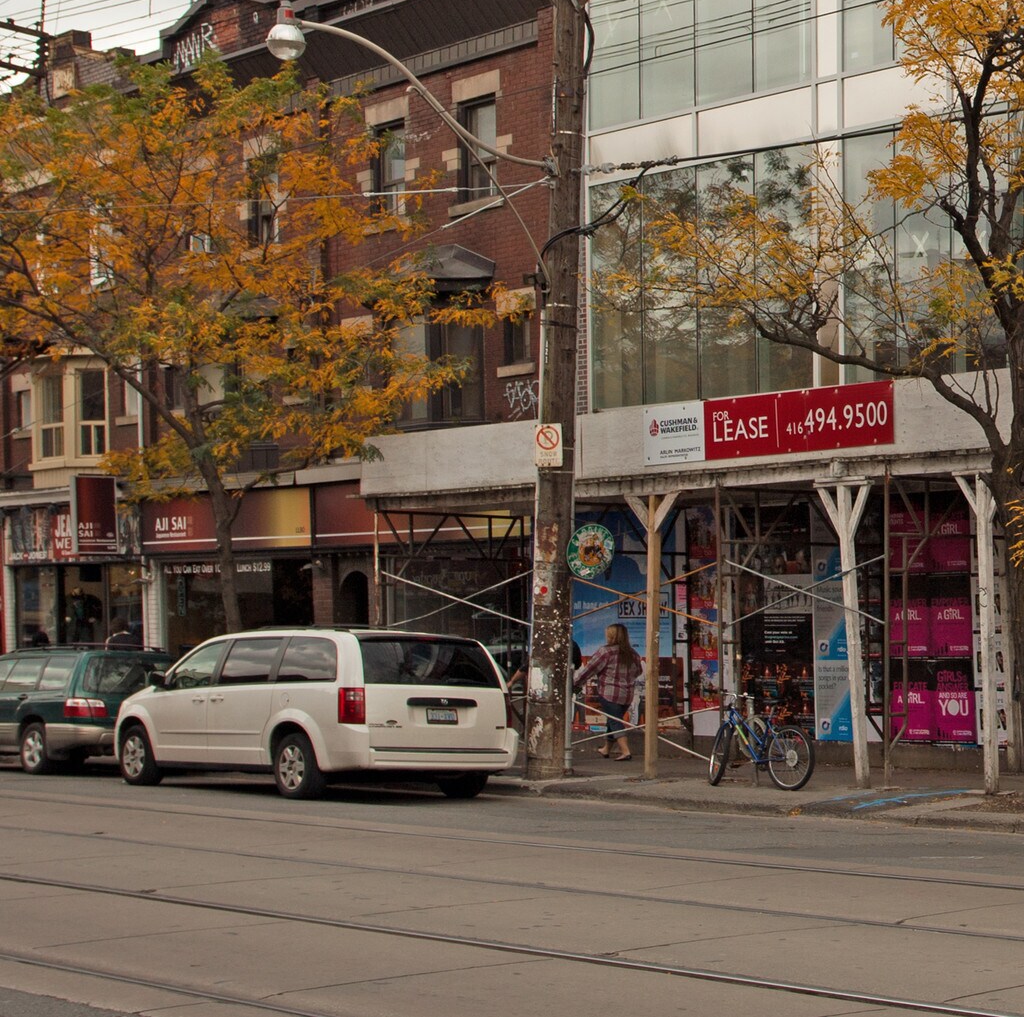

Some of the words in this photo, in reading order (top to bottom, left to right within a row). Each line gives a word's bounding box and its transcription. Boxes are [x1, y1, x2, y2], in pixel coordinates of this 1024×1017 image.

[713, 410, 729, 421] FOR
[660, 417, 692, 428] CUSHMAN
[713, 416, 769, 443] LEASE
[786, 421, 803, 435] 416
[804, 400, 887, 433] 494.9500
[660, 424, 697, 434] WAKEFIELD
[79, 522, 93, 530] AJI
[155, 517, 169, 531] AJI
[171, 516, 187, 531] SAI
[79, 530, 94, 538] SAI
[619, 601, 635, 616] SEX
[938, 698, 969, 716] YOU
